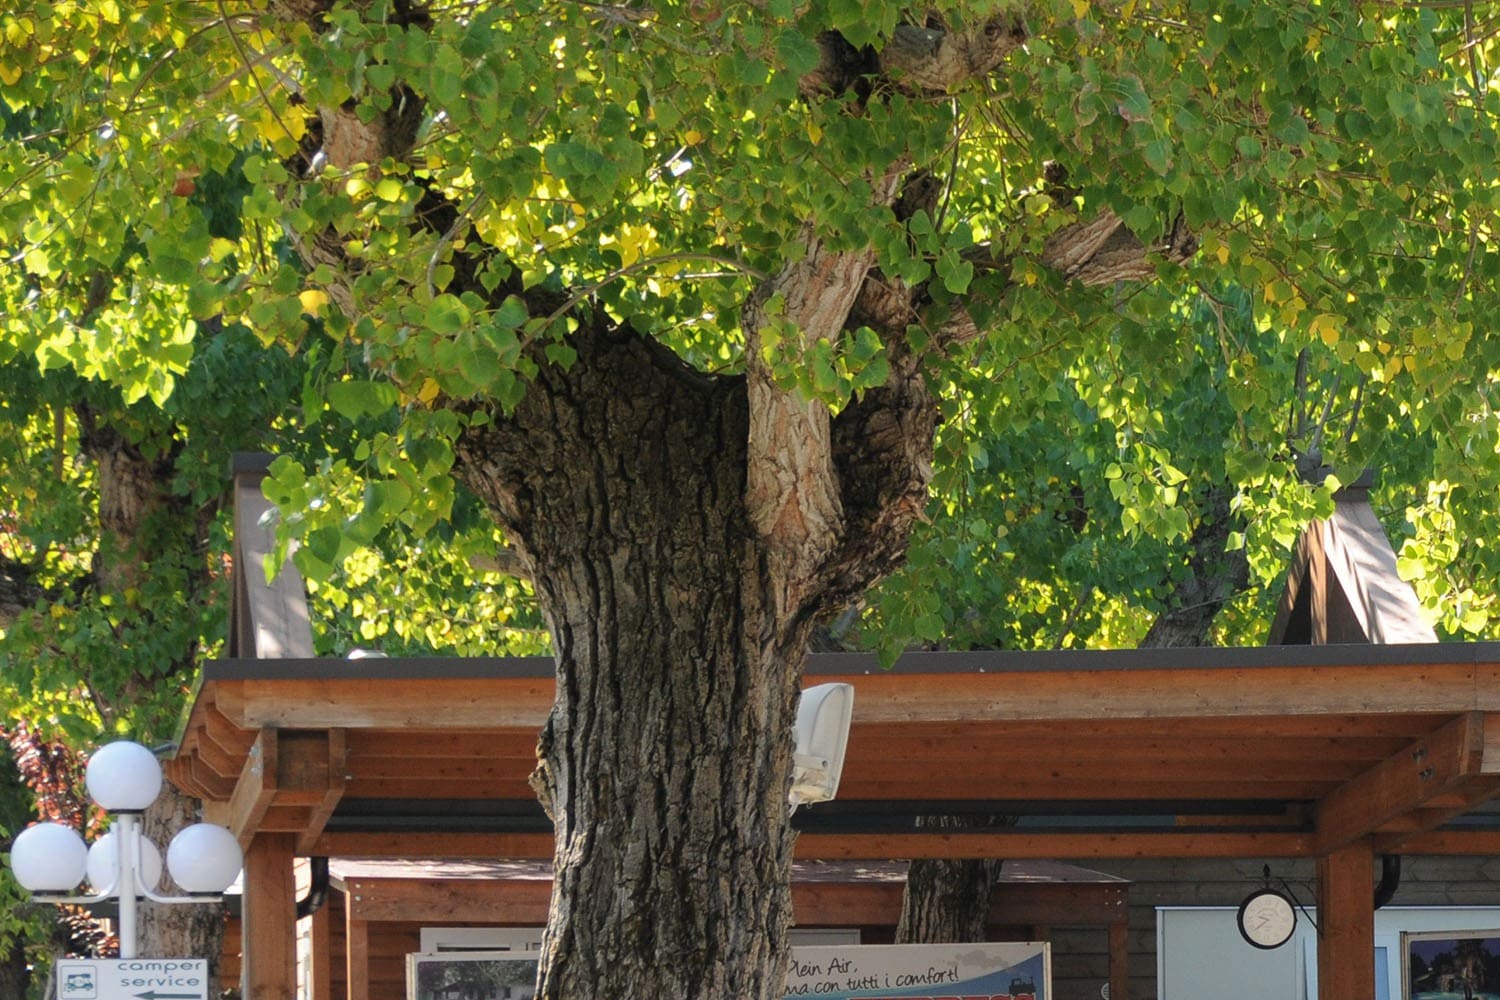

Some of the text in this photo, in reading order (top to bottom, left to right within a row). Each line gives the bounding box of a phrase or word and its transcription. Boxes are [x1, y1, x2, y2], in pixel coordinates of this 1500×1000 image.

[117, 962, 202, 974] camper
[120, 976, 200, 987] service
[814, 982, 841, 994] con
[846, 974, 880, 990] tutti
[885, 973, 890, 987] i
[895, 966, 960, 987] comfort!
